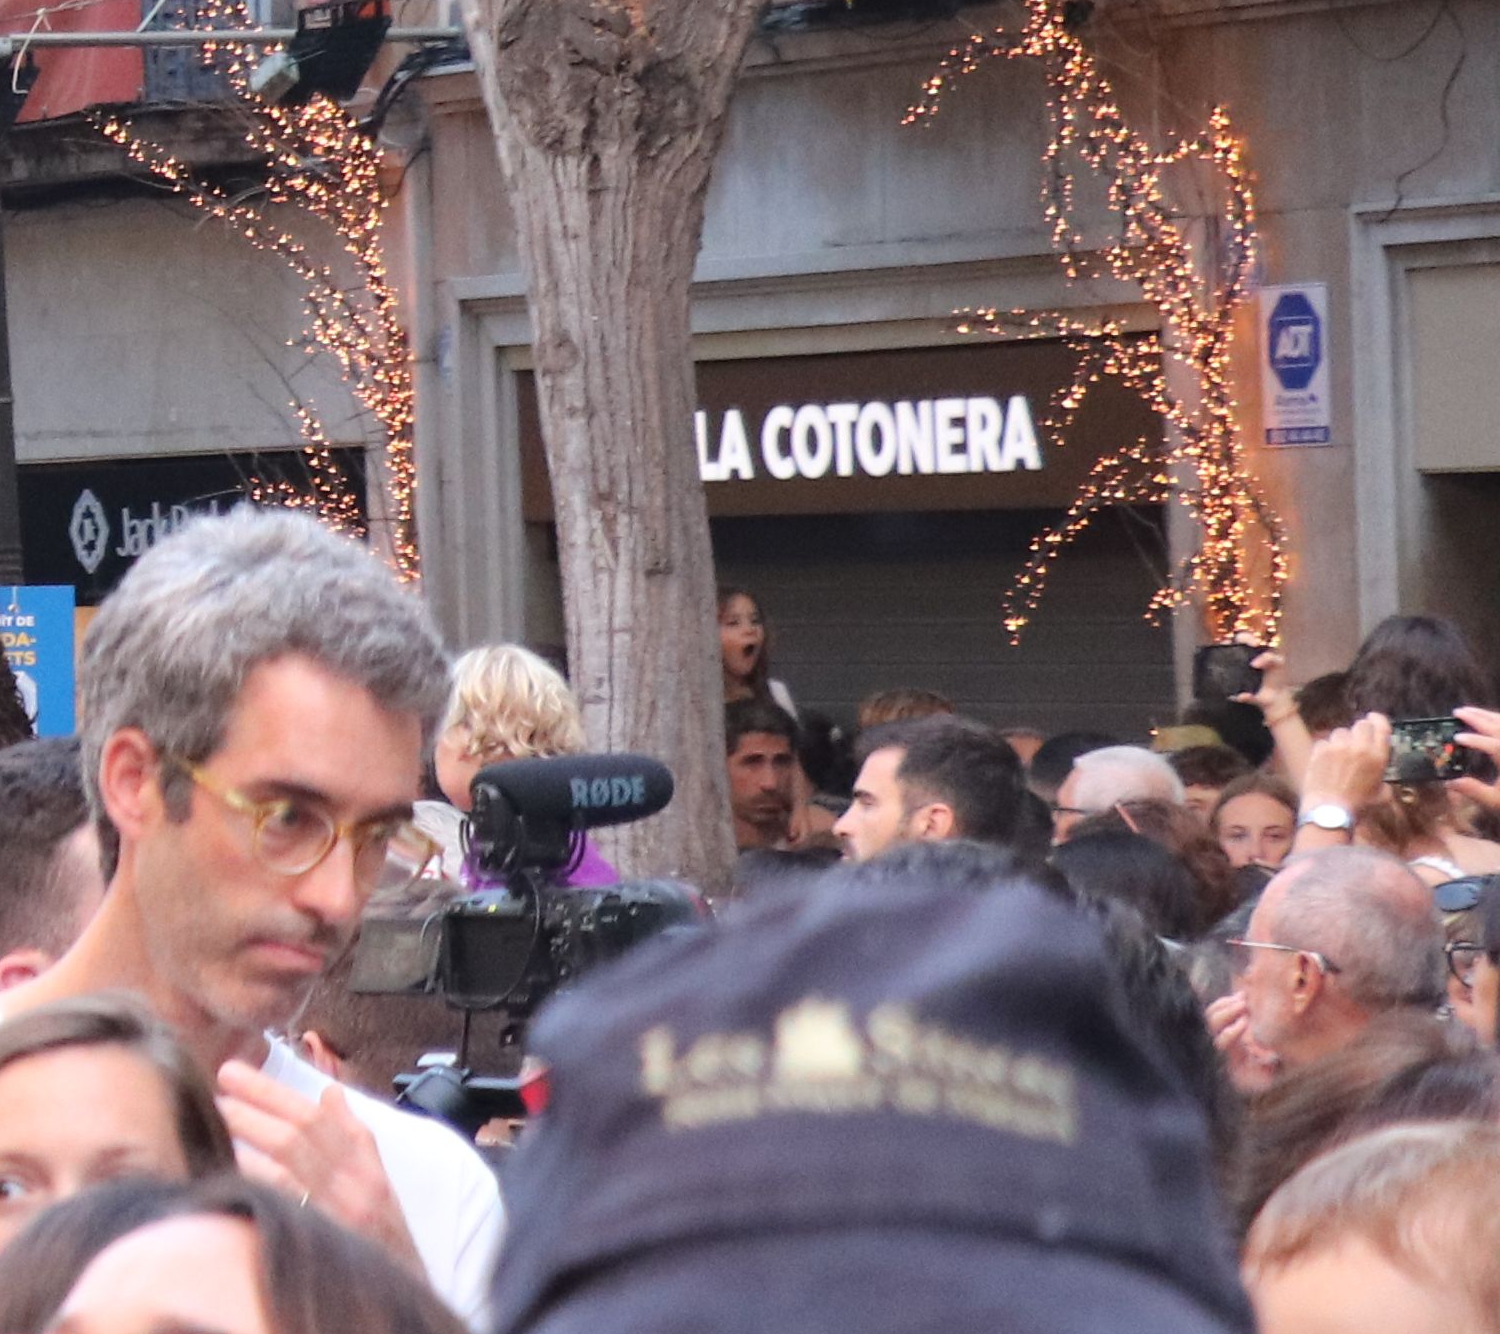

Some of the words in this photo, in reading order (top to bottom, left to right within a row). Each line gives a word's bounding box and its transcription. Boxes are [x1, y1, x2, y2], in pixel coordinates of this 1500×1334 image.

[1275, 325, 1314, 359] ADT
[695, 409, 754, 481] LA
[761, 395, 1042, 480] COTONERA
